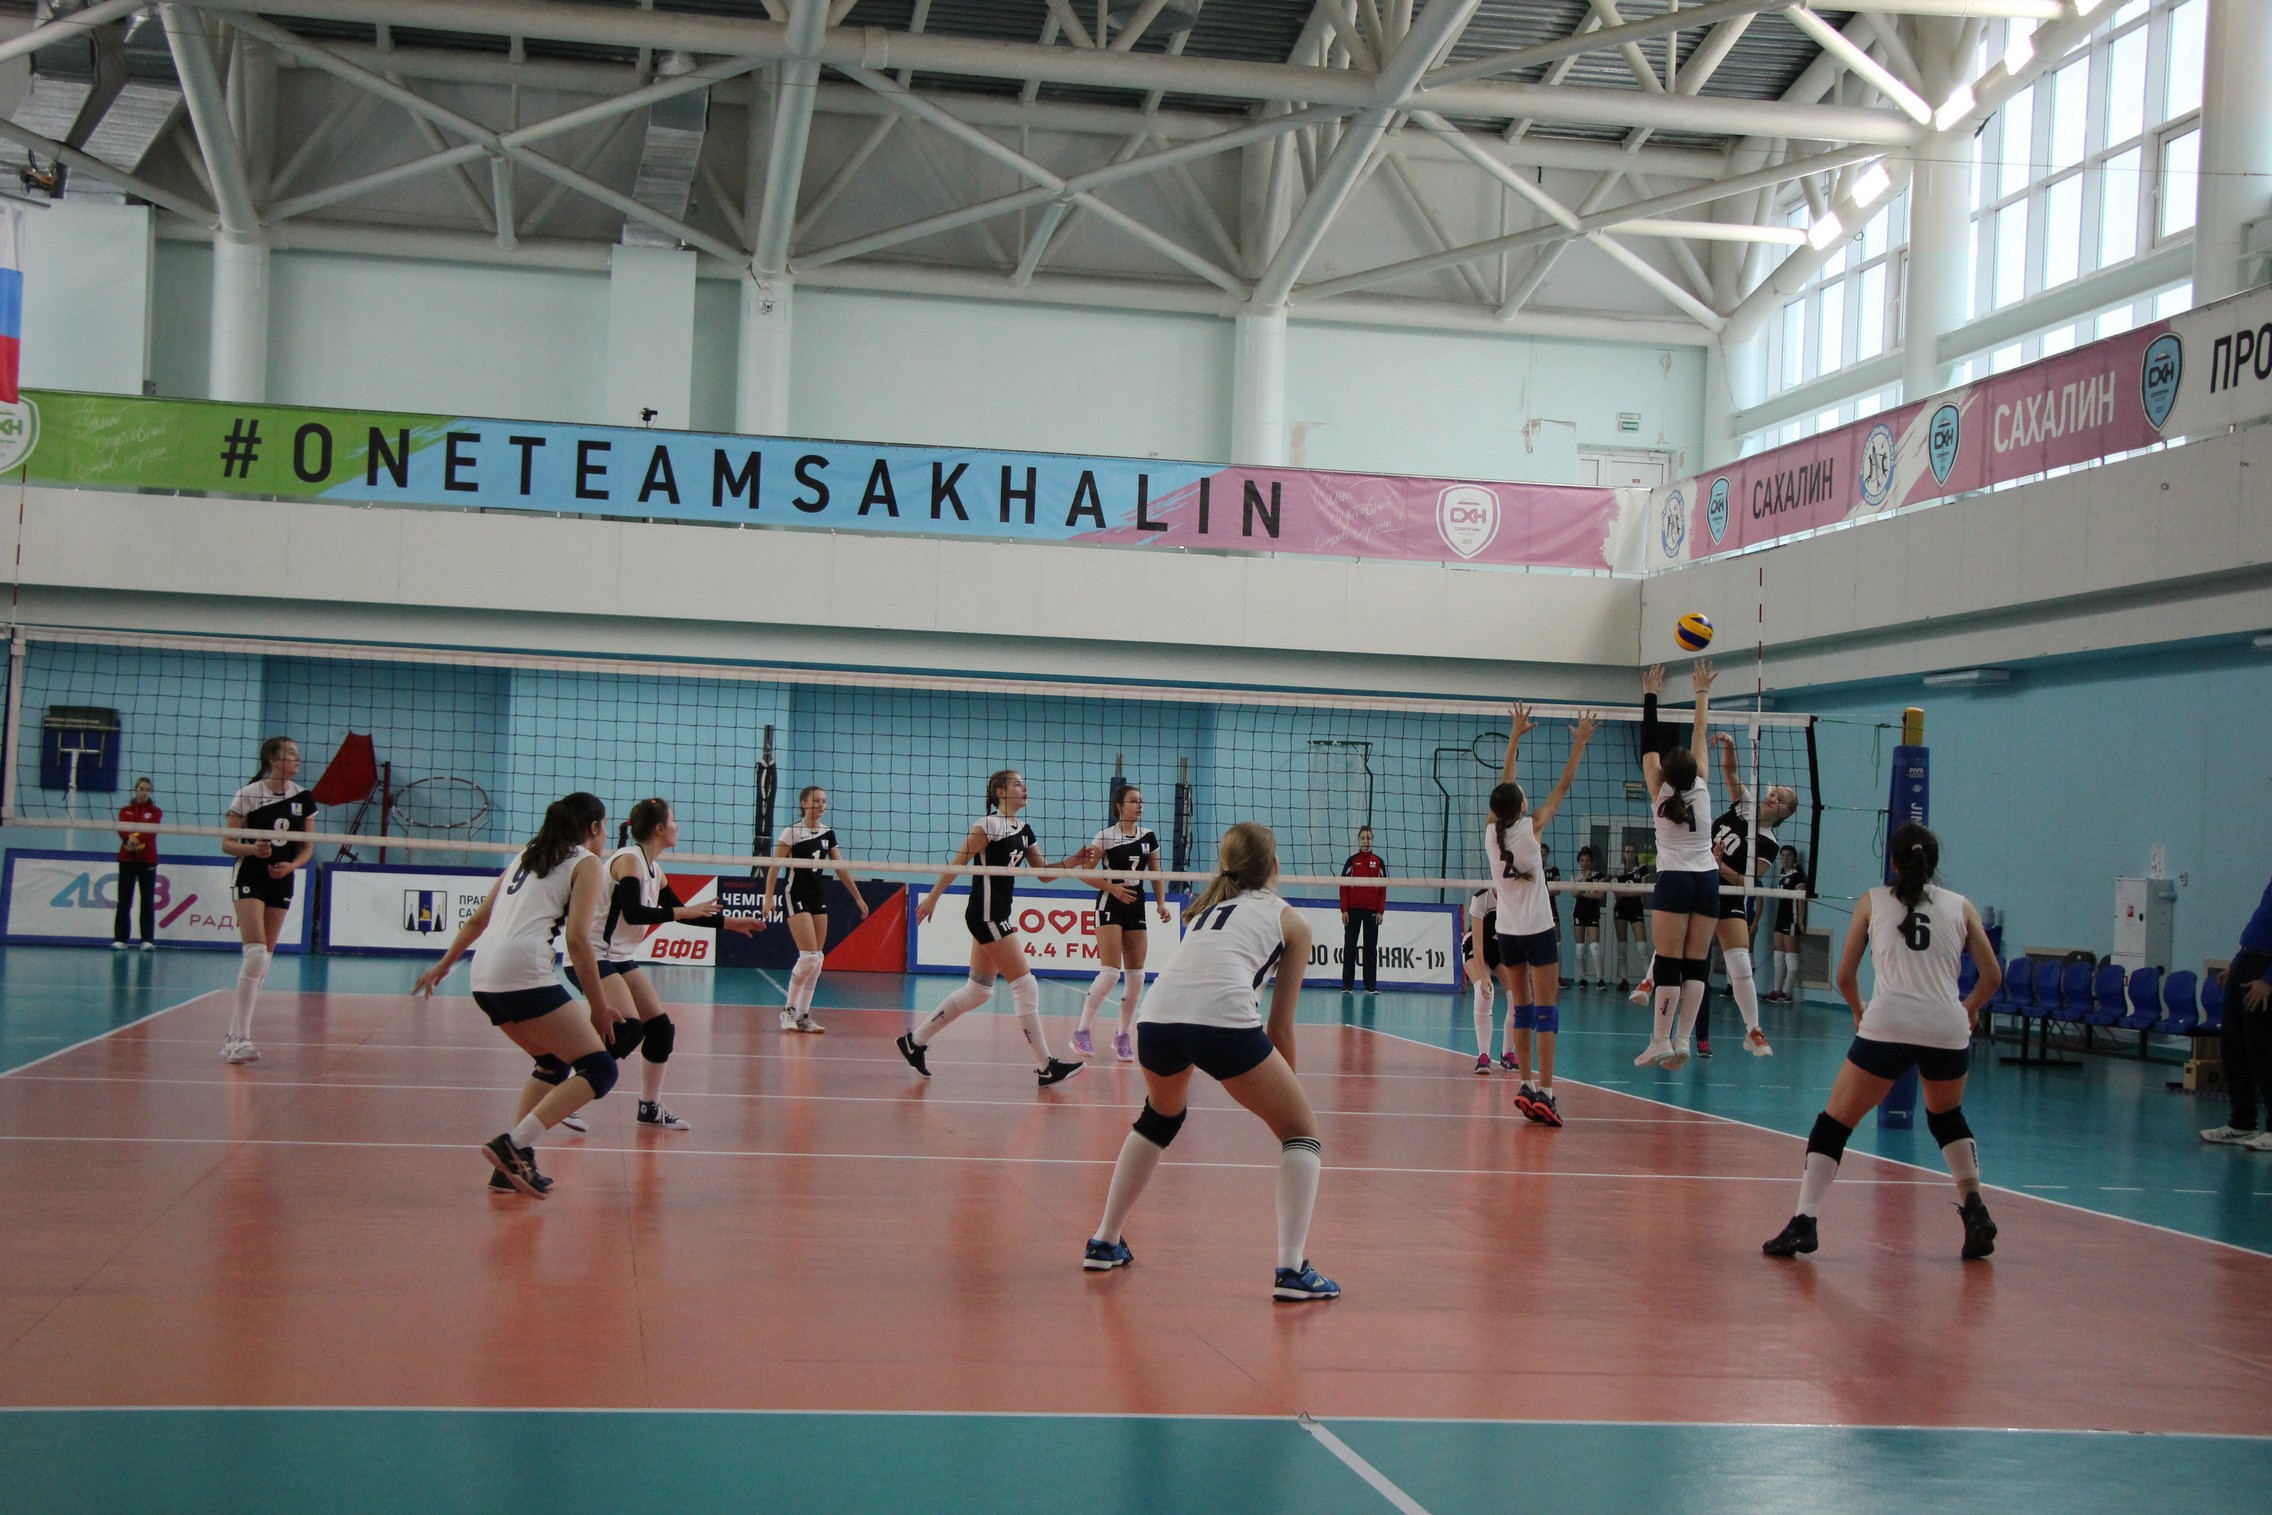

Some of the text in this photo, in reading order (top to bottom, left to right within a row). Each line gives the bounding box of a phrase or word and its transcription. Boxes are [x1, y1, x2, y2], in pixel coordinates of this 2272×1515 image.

[1993, 371, 2115, 453] САХАЛИН
[221, 418, 1282, 538] #ONETEAMSAKHALIN
[1753, 458, 1834, 519] САХАЛИН
[812, 850, 821, 872] 1
[1129, 856, 1140, 872] 7
[1500, 850, 1517, 878] 2
[507, 862, 531, 895] 9
[190, 914, 240, 930] РАД
[1000, 920, 1011, 932] 11
[1105, 912, 1111, 921] 7
[1192, 903, 1238, 931] 11
[1905, 912, 1931, 951] 6
[651, 938, 709, 960] ВФВ
